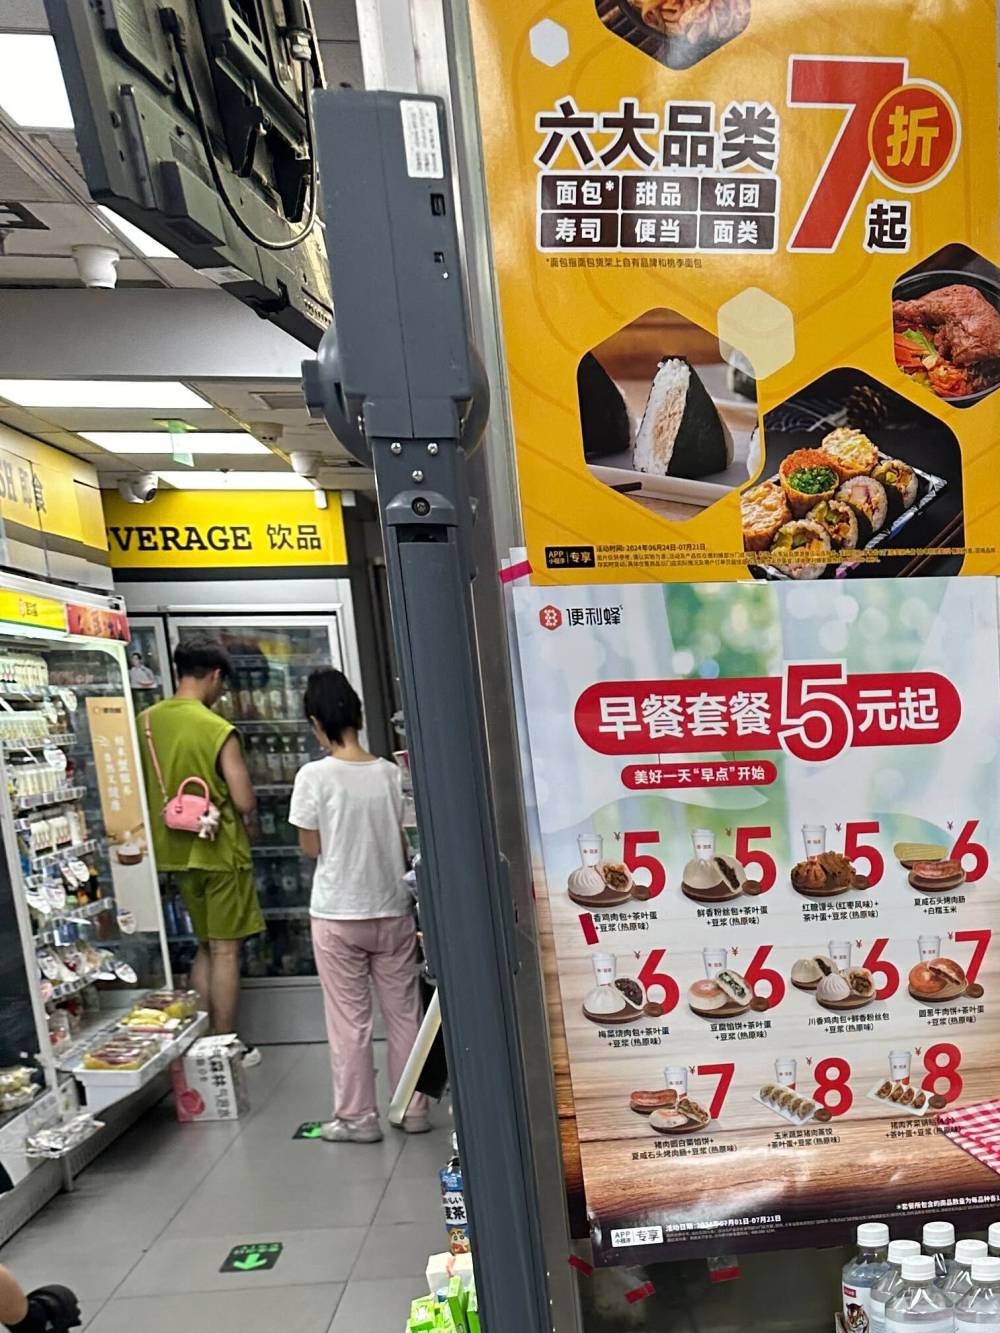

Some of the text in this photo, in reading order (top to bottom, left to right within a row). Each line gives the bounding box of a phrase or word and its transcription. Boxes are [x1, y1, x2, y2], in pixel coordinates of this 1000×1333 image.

[537, 100, 778, 171] 六大品类
[789, 57, 941, 251] 7 折
[635, 180, 682, 207] 甜品
[713, 181, 761, 208] 饭团
[555, 216, 759, 246] 寿司 便当 面类
[868, 203, 908, 250] 起
[108, 523, 322, 551] VERAGE 饮品
[548, 550, 565, 558] APP
[569, 552, 592, 564] 专享
[566, 606, 622, 626] 便利蜂
[614, 1231, 631, 1239] APP
[635, 1229, 659, 1242] 专享
